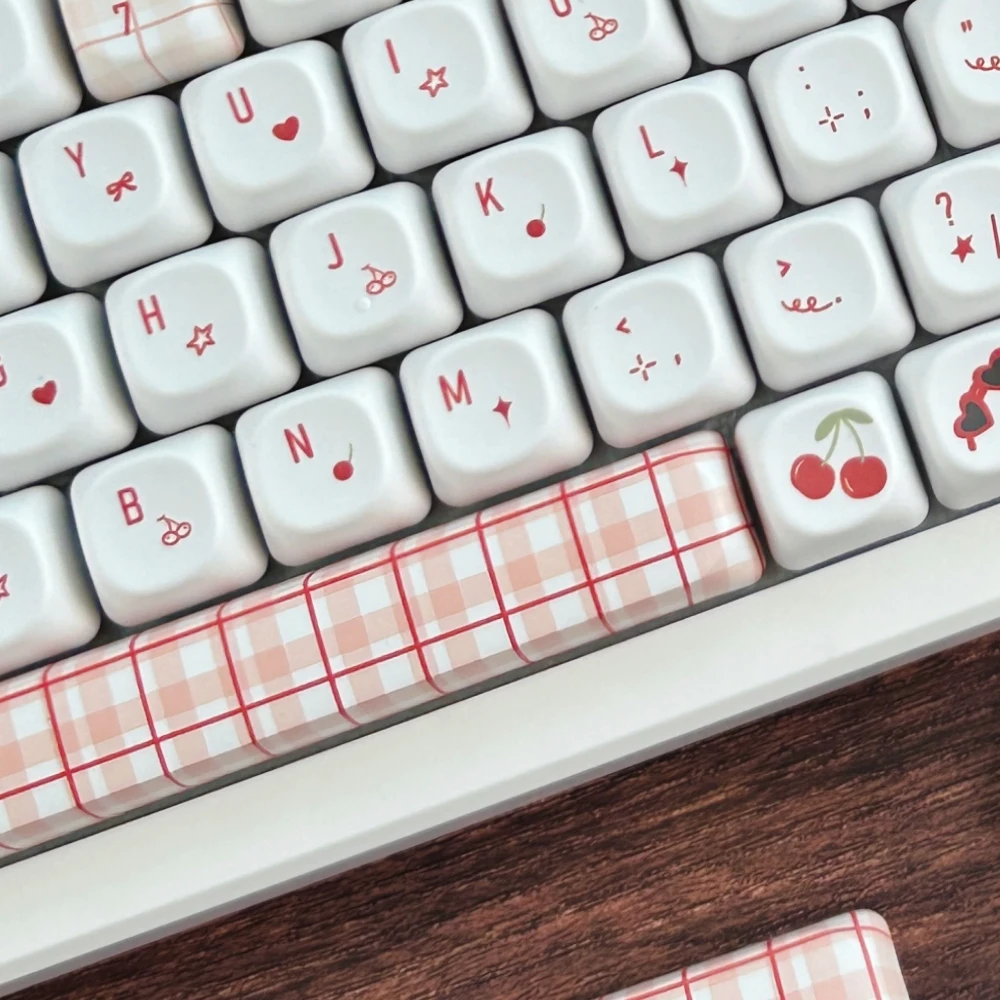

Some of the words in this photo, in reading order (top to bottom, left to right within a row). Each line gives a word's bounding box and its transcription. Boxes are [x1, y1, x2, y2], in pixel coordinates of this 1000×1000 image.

[112, 1, 132, 35] 7
[386, 40, 399, 73] I
[227, 88, 253, 123] U
[640, 126, 664, 158] L
[64, 143, 85, 177] Y
[476, 178, 503, 216] K
[936, 192, 954, 226] ?
[329, 234, 343, 269] J
[139, 296, 165, 334] H
[440, 370, 471, 411] M
[285, 424, 313, 463] N
[118, 488, 143, 525] B
